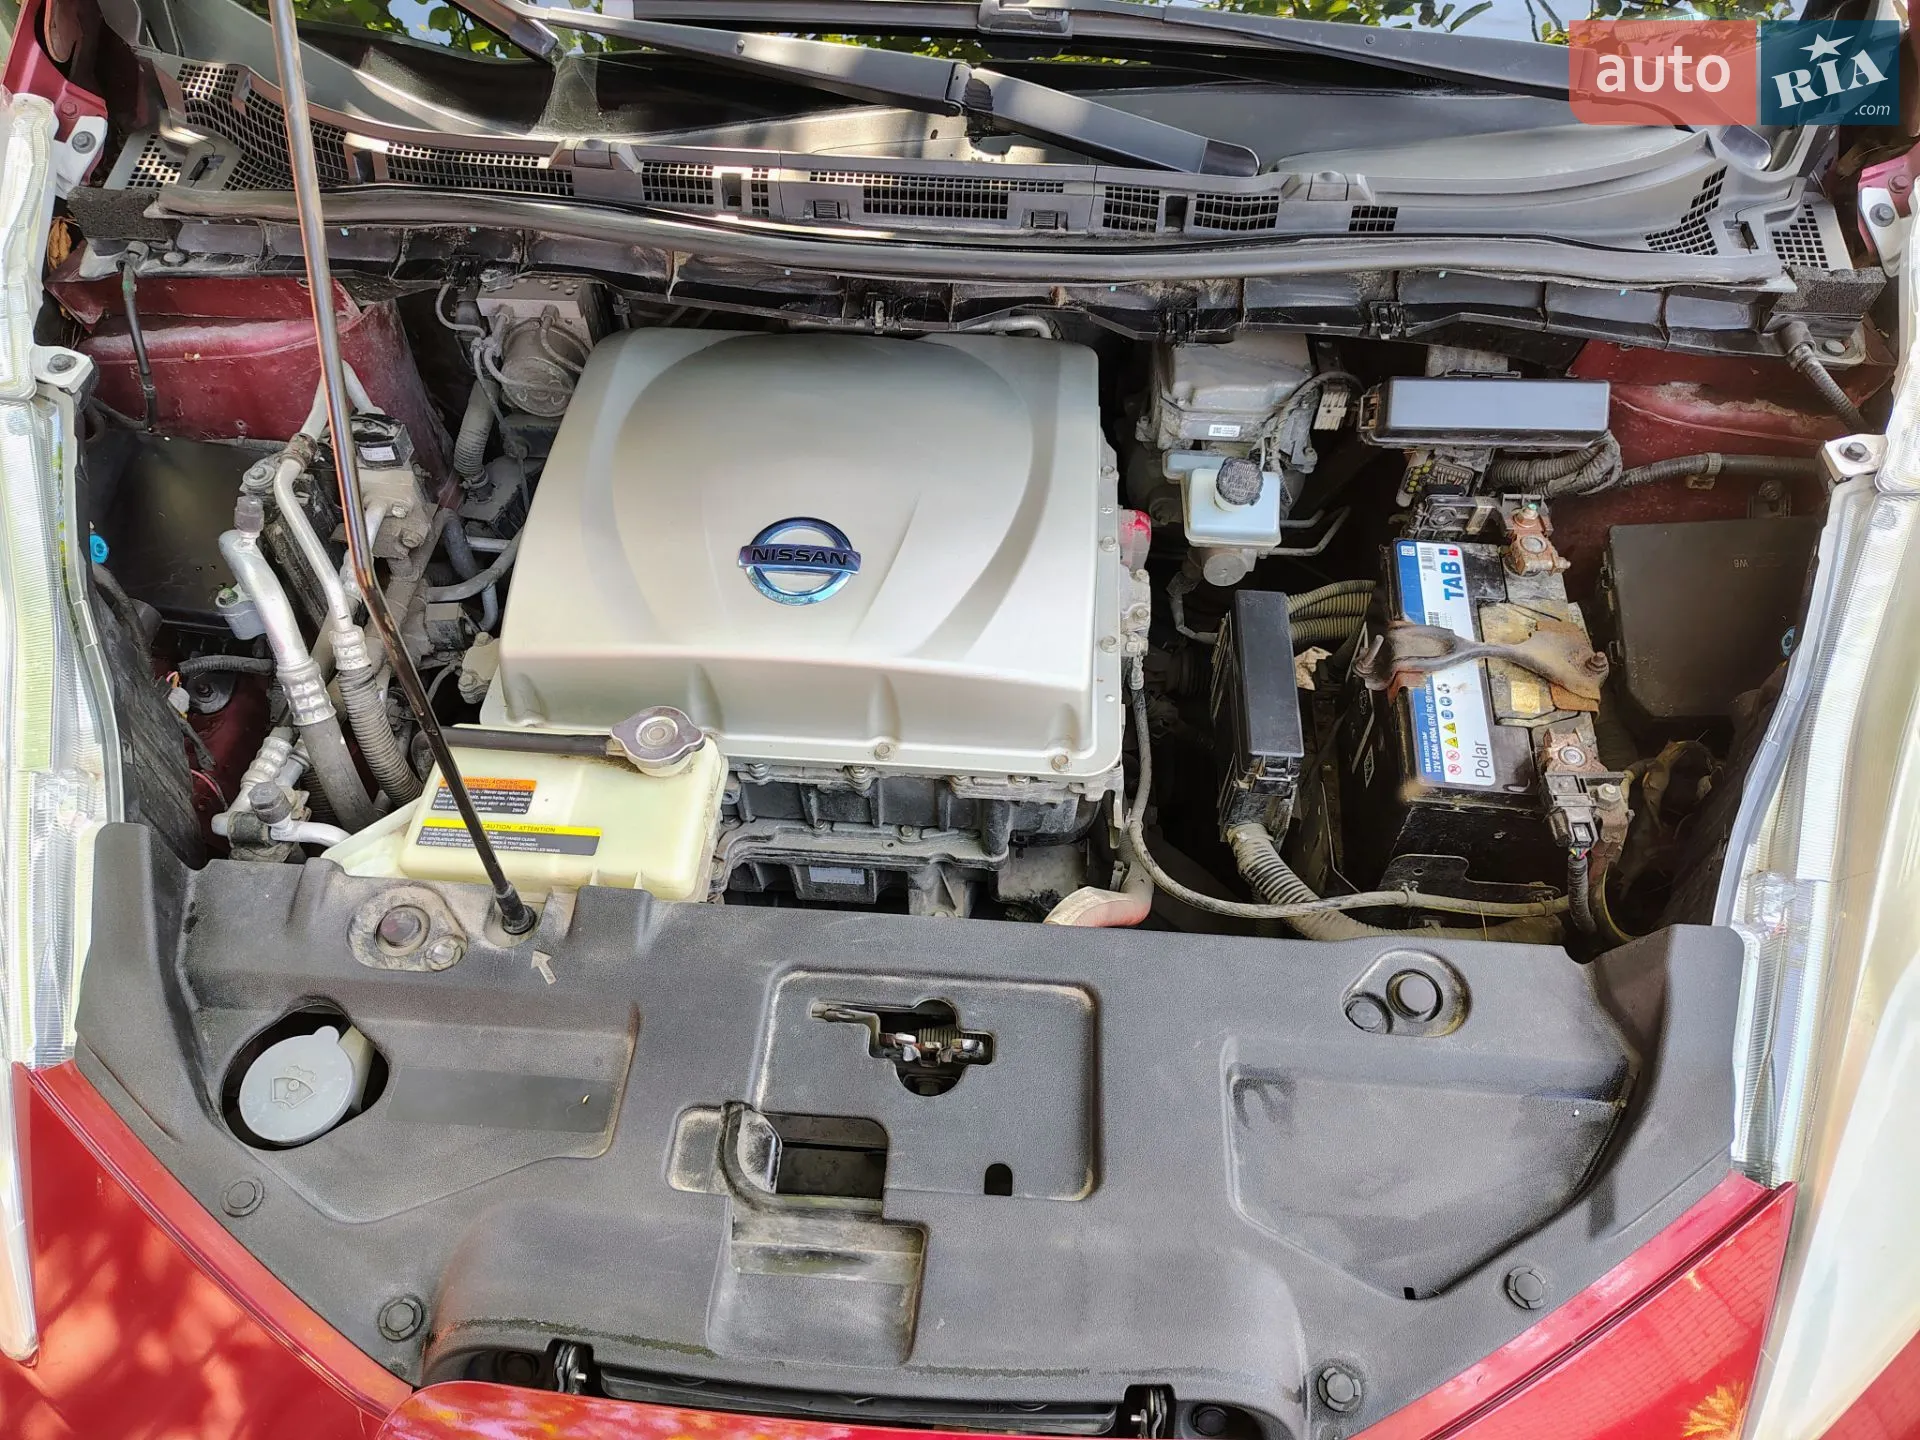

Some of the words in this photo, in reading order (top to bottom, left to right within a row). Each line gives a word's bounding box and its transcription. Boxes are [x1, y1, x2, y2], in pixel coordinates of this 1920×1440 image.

[752, 547, 847, 566] NISSAN
[1441, 561, 1465, 601] TAB
[1433, 760, 1442, 773] 12V
[1472, 740, 1492, 778] Polar
